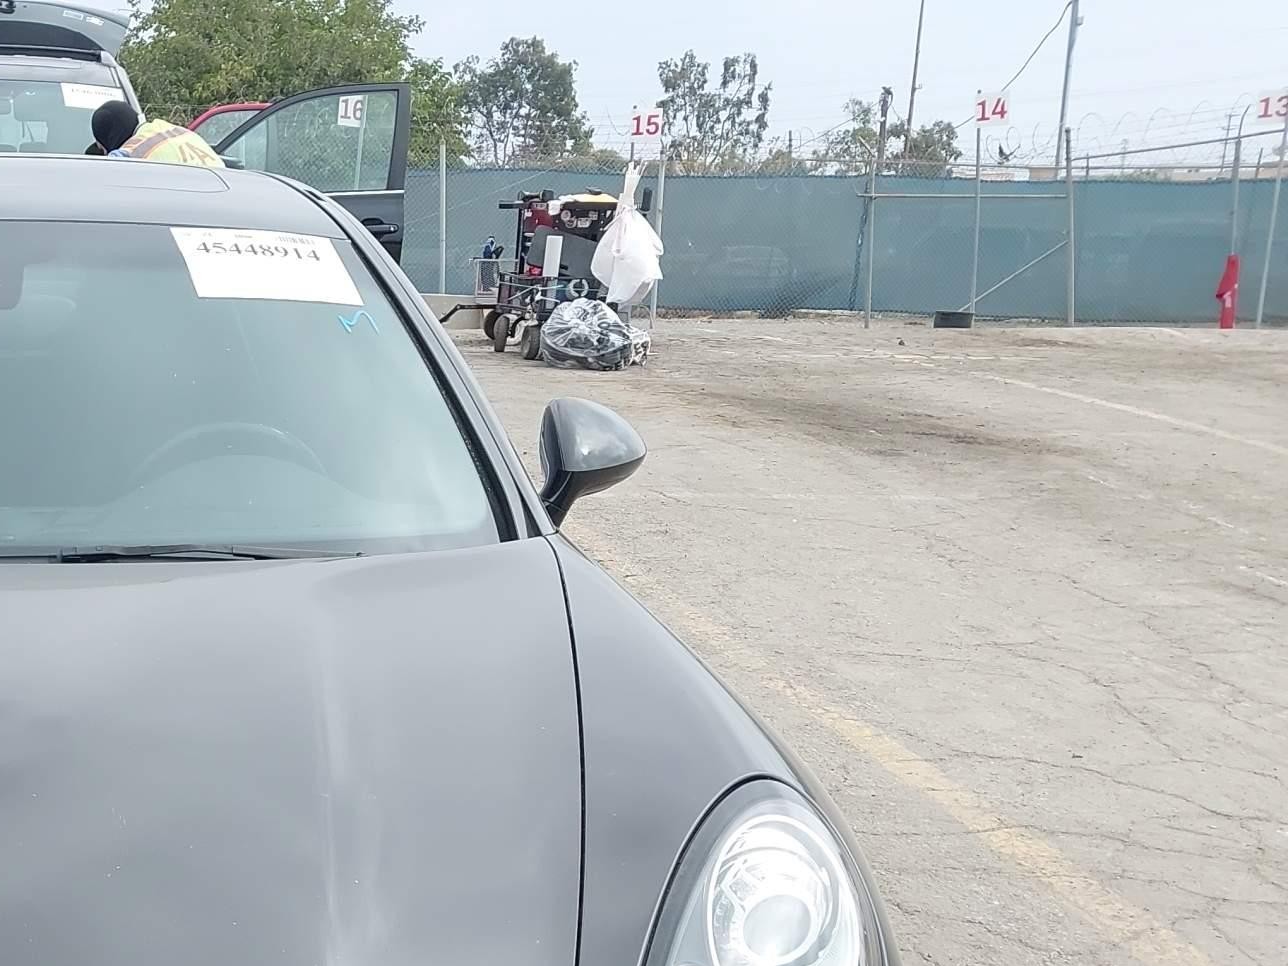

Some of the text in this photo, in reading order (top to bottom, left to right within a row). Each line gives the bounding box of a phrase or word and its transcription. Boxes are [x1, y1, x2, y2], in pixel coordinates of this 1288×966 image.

[340, 98, 364, 121] 16
[976, 97, 1008, 122] 14
[631, 114, 660, 136] 15
[196, 241, 321, 262] 45448914
